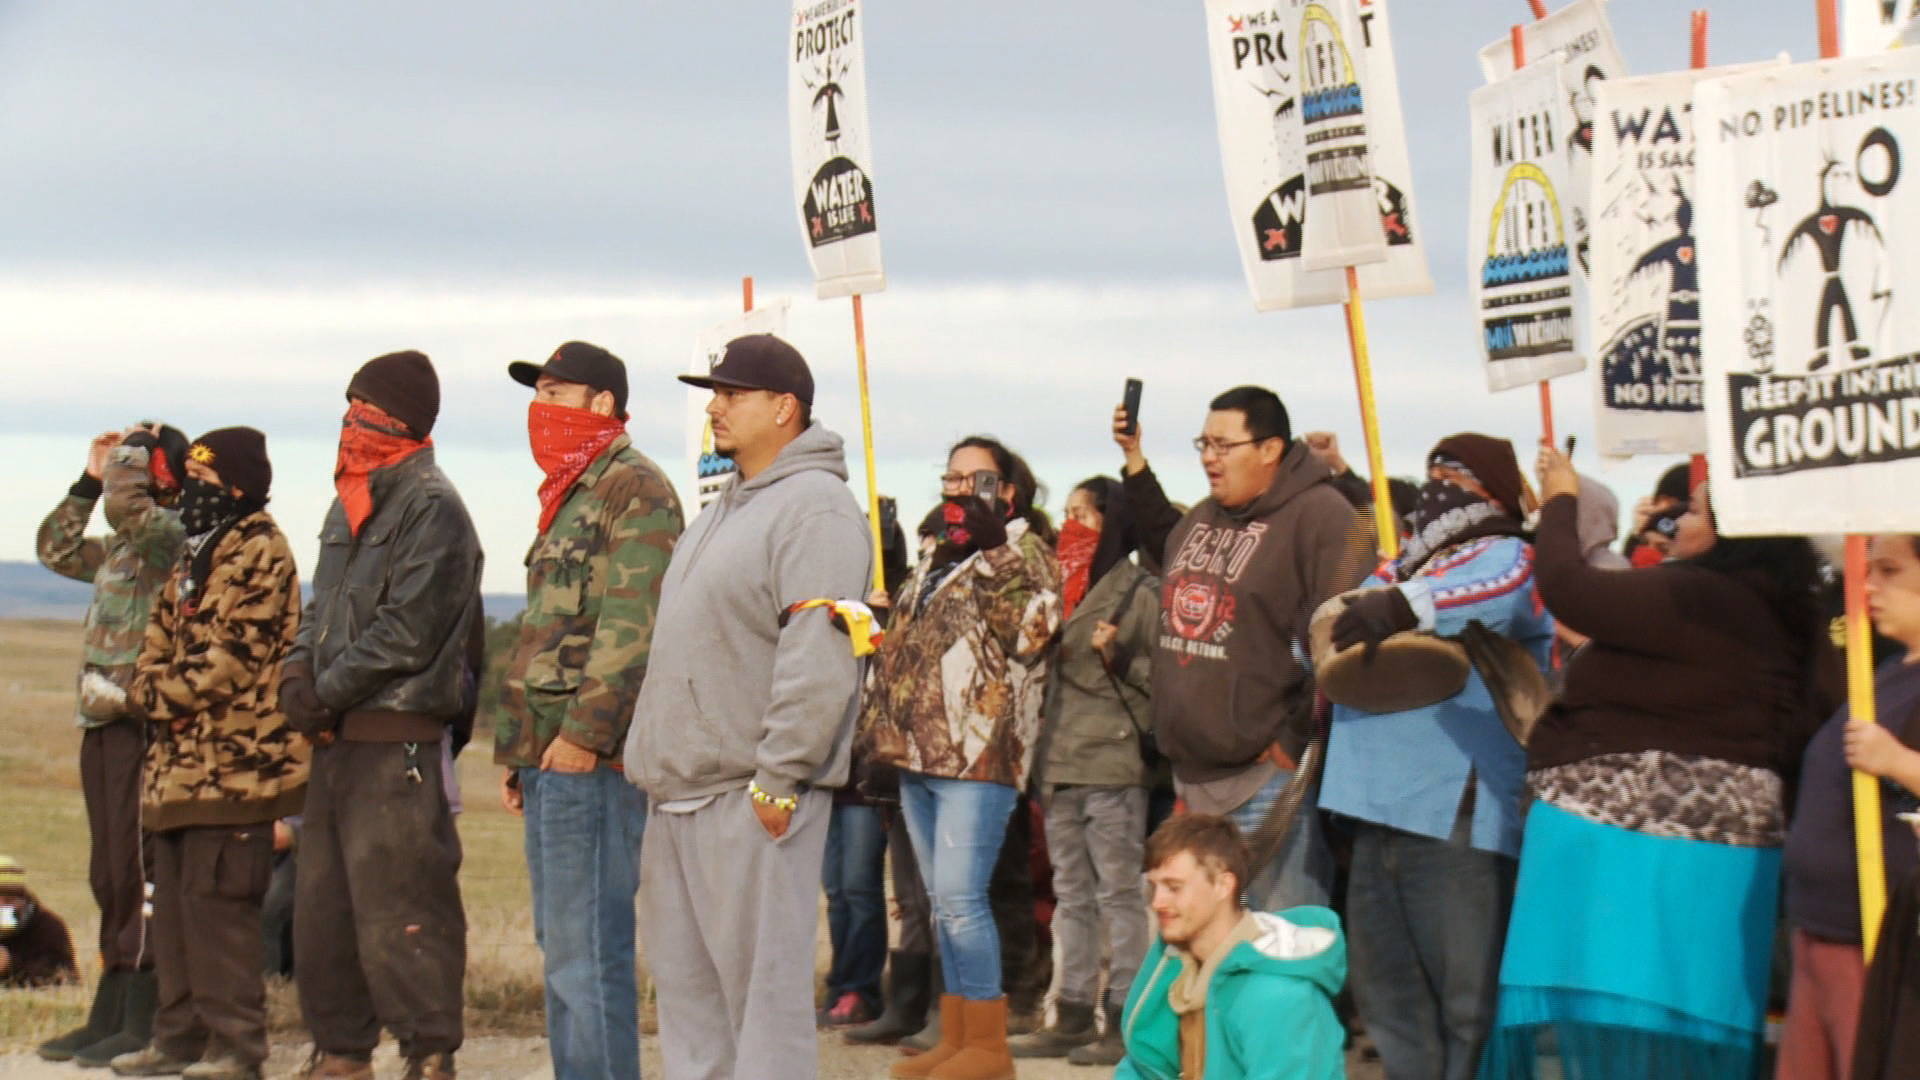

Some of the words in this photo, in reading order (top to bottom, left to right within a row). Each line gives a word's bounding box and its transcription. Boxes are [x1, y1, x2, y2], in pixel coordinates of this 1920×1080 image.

[796, 9, 854, 63] PROTECT
[1247, 11, 1267, 27] WE
[1719, 110, 1762, 143] NO
[1774, 79, 1915, 131] PIPELINES!
[1491, 110, 1554, 167] WATER
[812, 170, 866, 214] WATER
[1614, 382, 1651, 405] NO
[1740, 376, 1806, 412] KEEP
[1807, 375, 1835, 404] IT
[1743, 396, 1920, 468] GROUND
